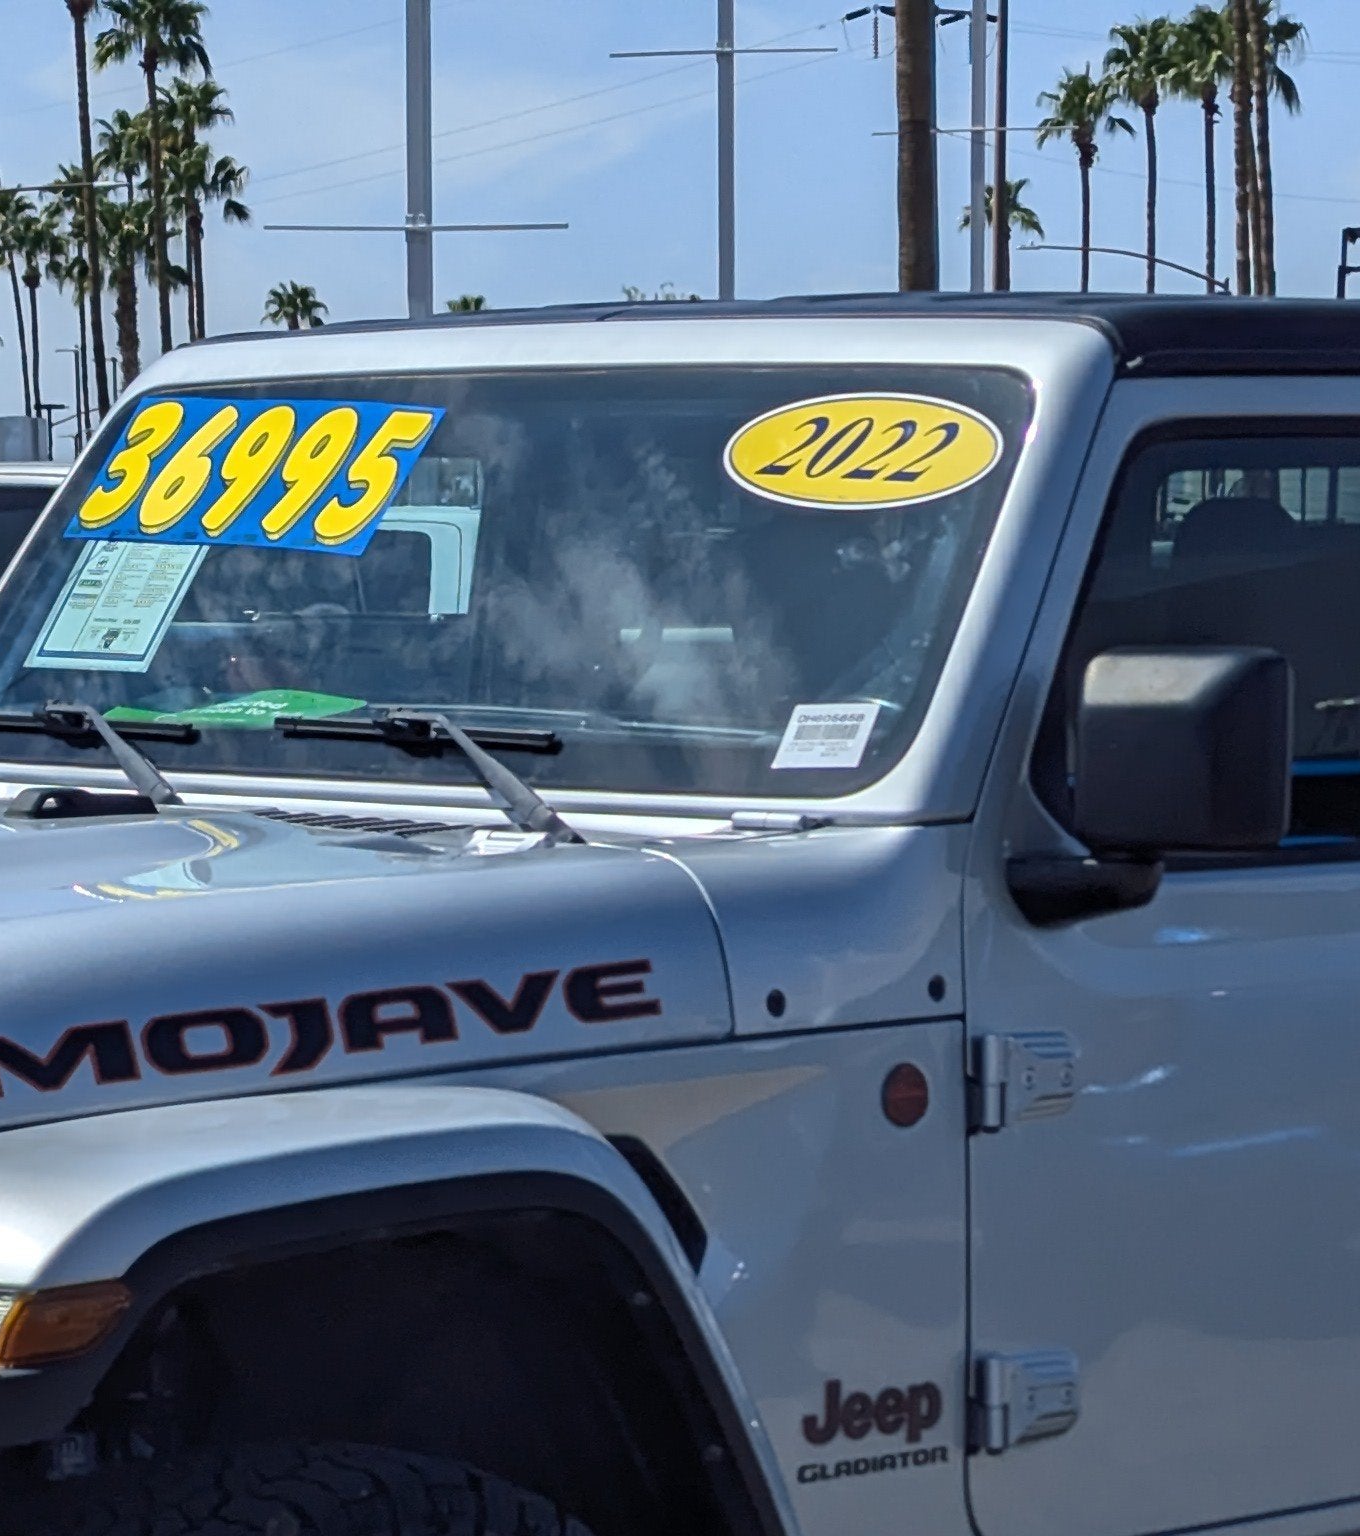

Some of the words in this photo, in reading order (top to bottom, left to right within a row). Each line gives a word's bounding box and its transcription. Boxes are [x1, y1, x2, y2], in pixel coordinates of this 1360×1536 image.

[78, 400, 434, 546] 36995
[754, 416, 960, 482] 2022
[801, 1378, 942, 1446] Jeep
[797, 1446, 948, 1484] GLADIATOR
